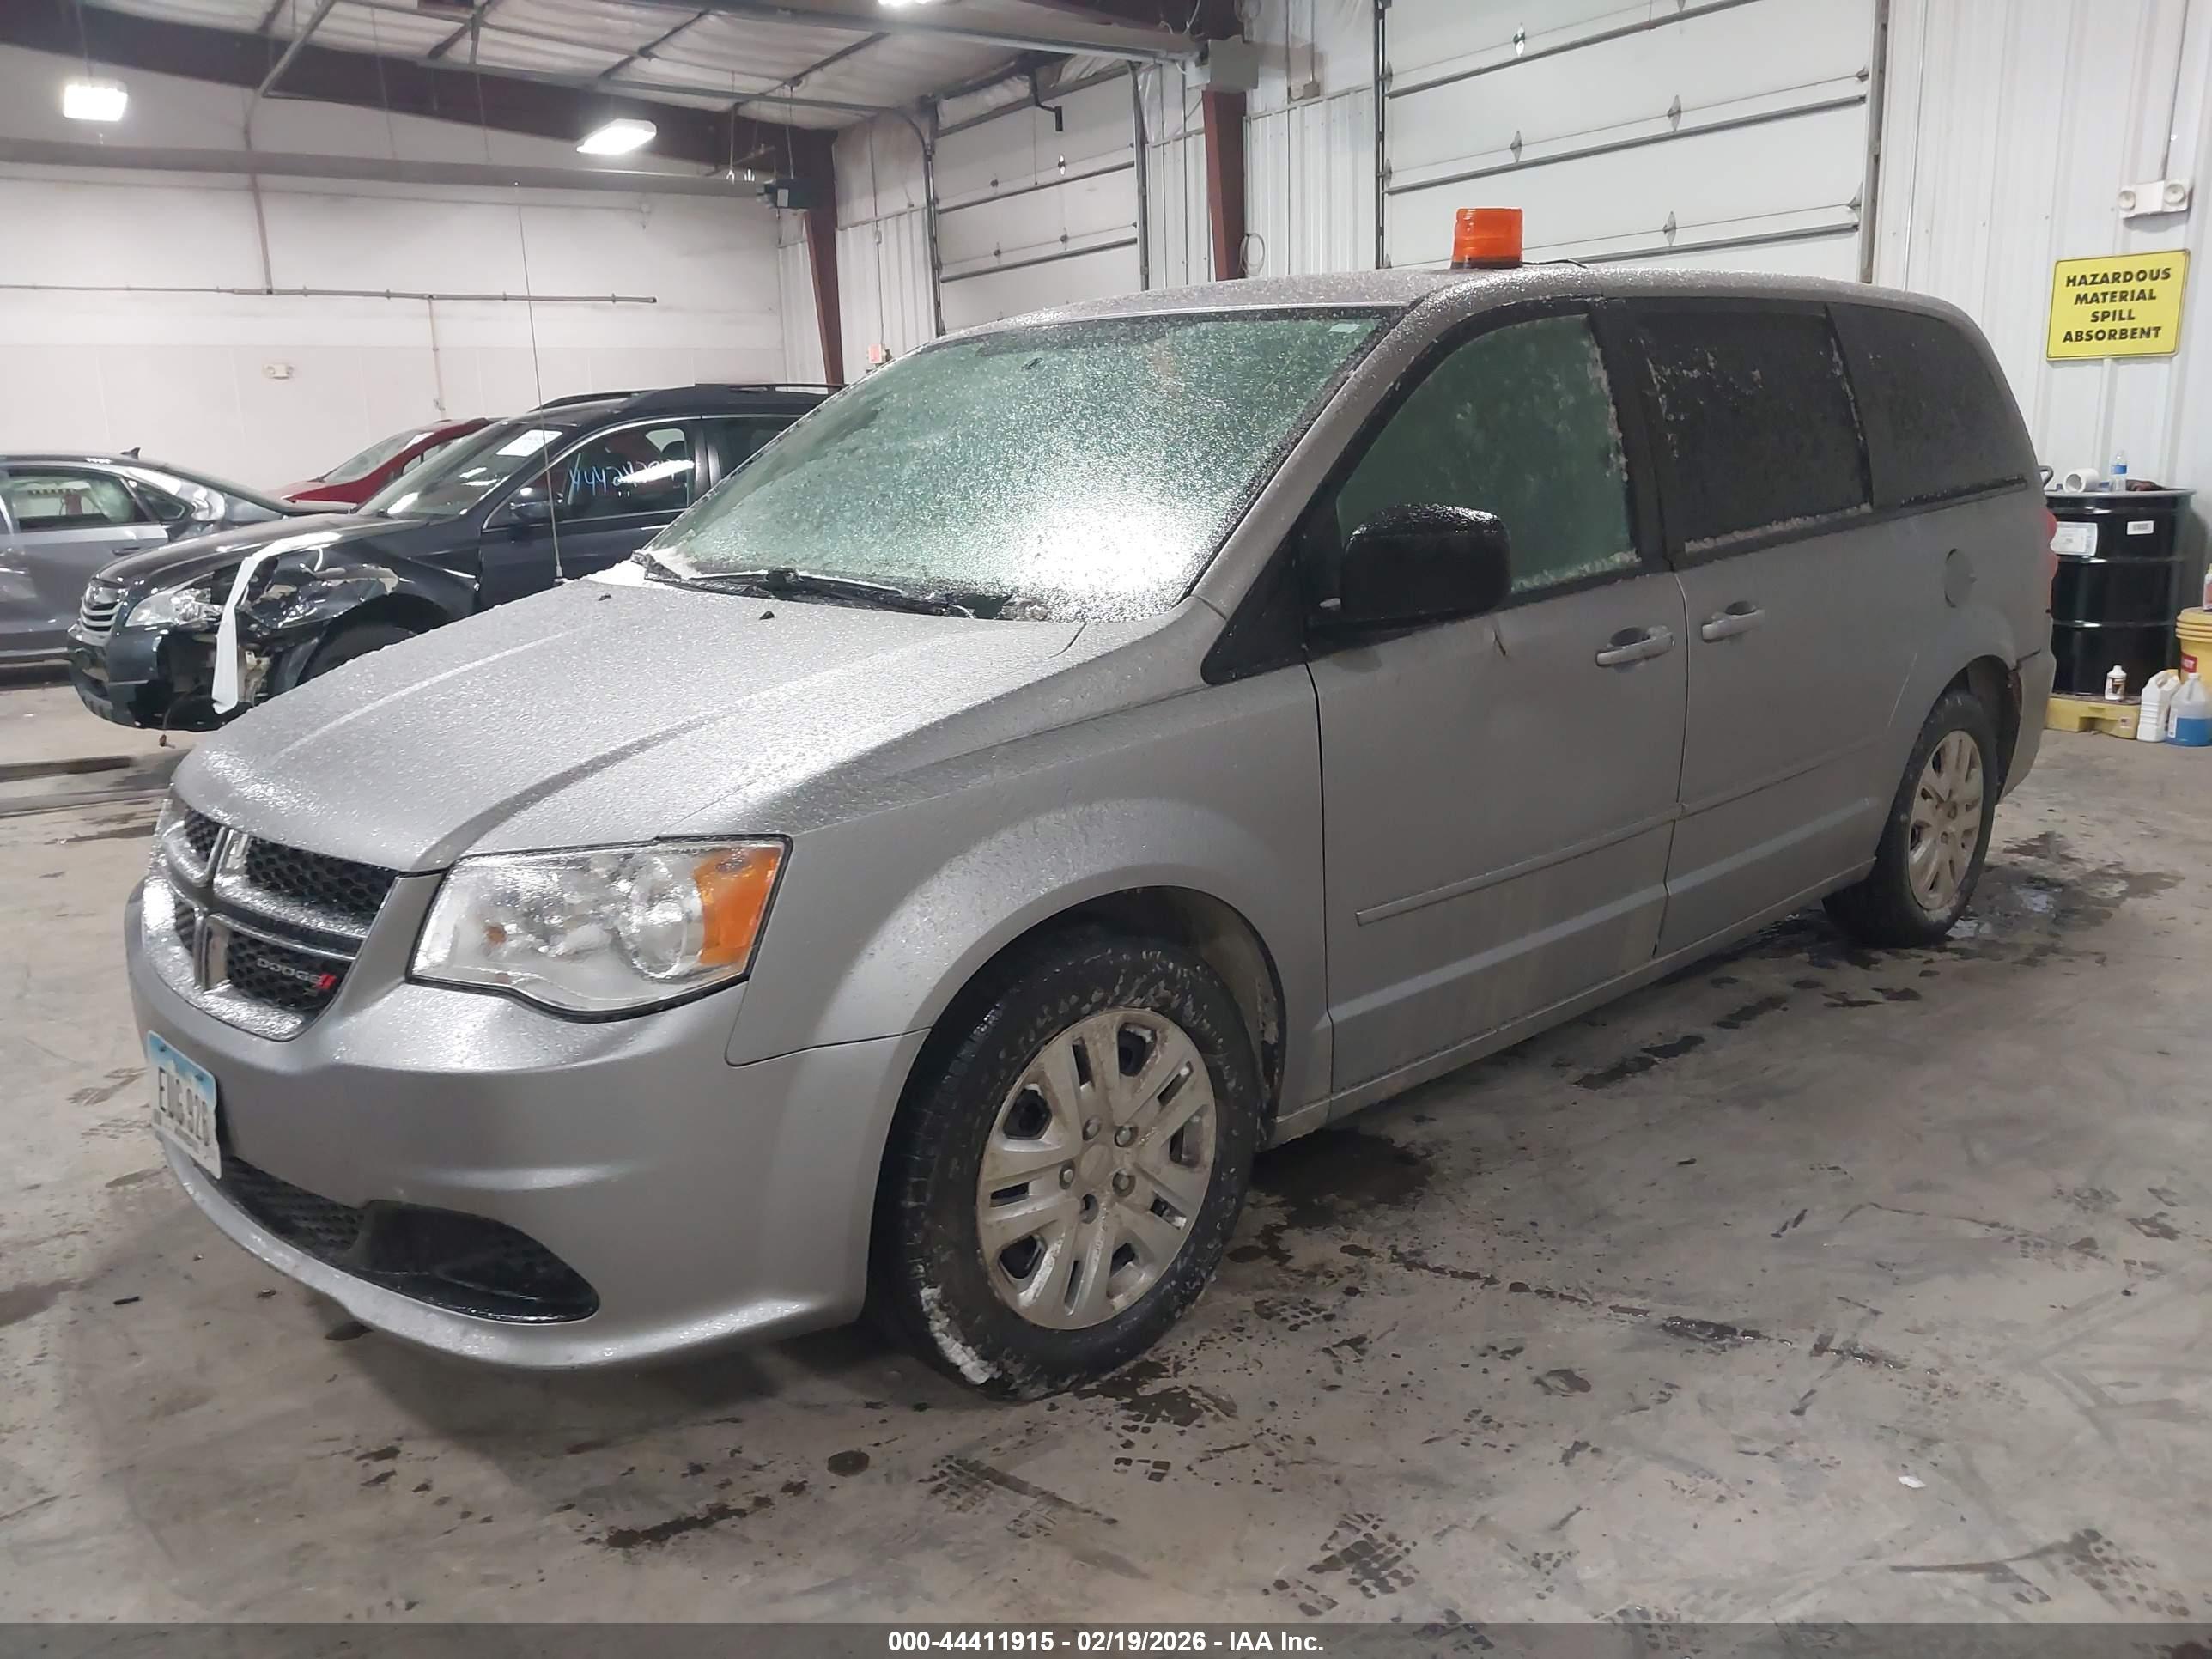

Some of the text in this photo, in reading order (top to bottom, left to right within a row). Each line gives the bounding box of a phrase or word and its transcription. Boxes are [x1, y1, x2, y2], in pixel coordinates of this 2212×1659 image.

[2065, 268, 2172, 288] HAZARDOUS
[2074, 289, 2157, 306] MATERIAL
[2090, 308, 2136, 323] SPILL
[2063, 326, 2162, 343] ABSORBENT
[256, 957, 321, 984] DODGE
